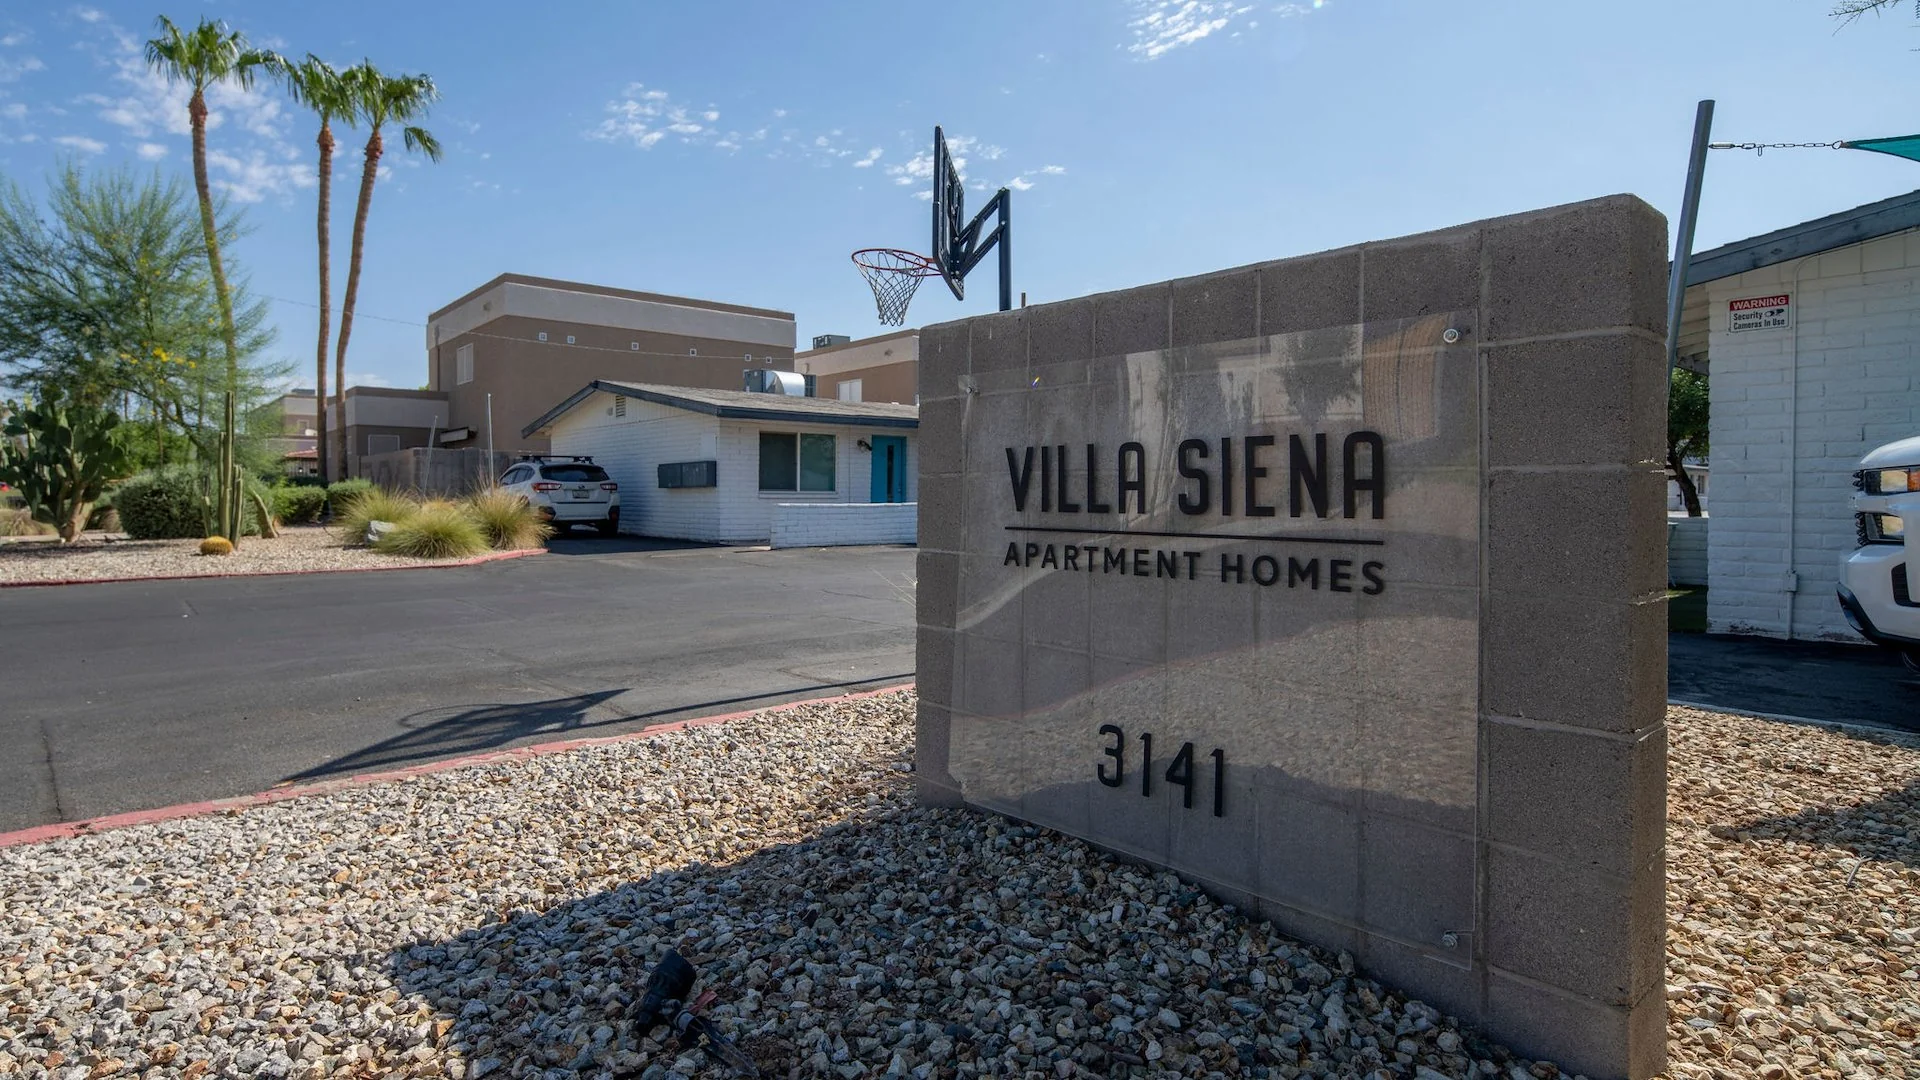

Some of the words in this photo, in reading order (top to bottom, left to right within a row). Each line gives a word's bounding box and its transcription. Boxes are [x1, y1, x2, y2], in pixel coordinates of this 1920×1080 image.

[1732, 296, 1786, 310] WARNING
[1733, 311, 1763, 321] Security
[1733, 321, 1762, 330] Cameras
[1764, 319, 1771, 327] In
[1772, 318, 1785, 326] Use
[1005, 441, 1146, 514] VILLA
[1178, 431, 1385, 520] SIENA
[1003, 541, 1201, 581] APARTMENT
[1221, 553, 1384, 596] HOMES
[1097, 724, 1224, 817] 3141
